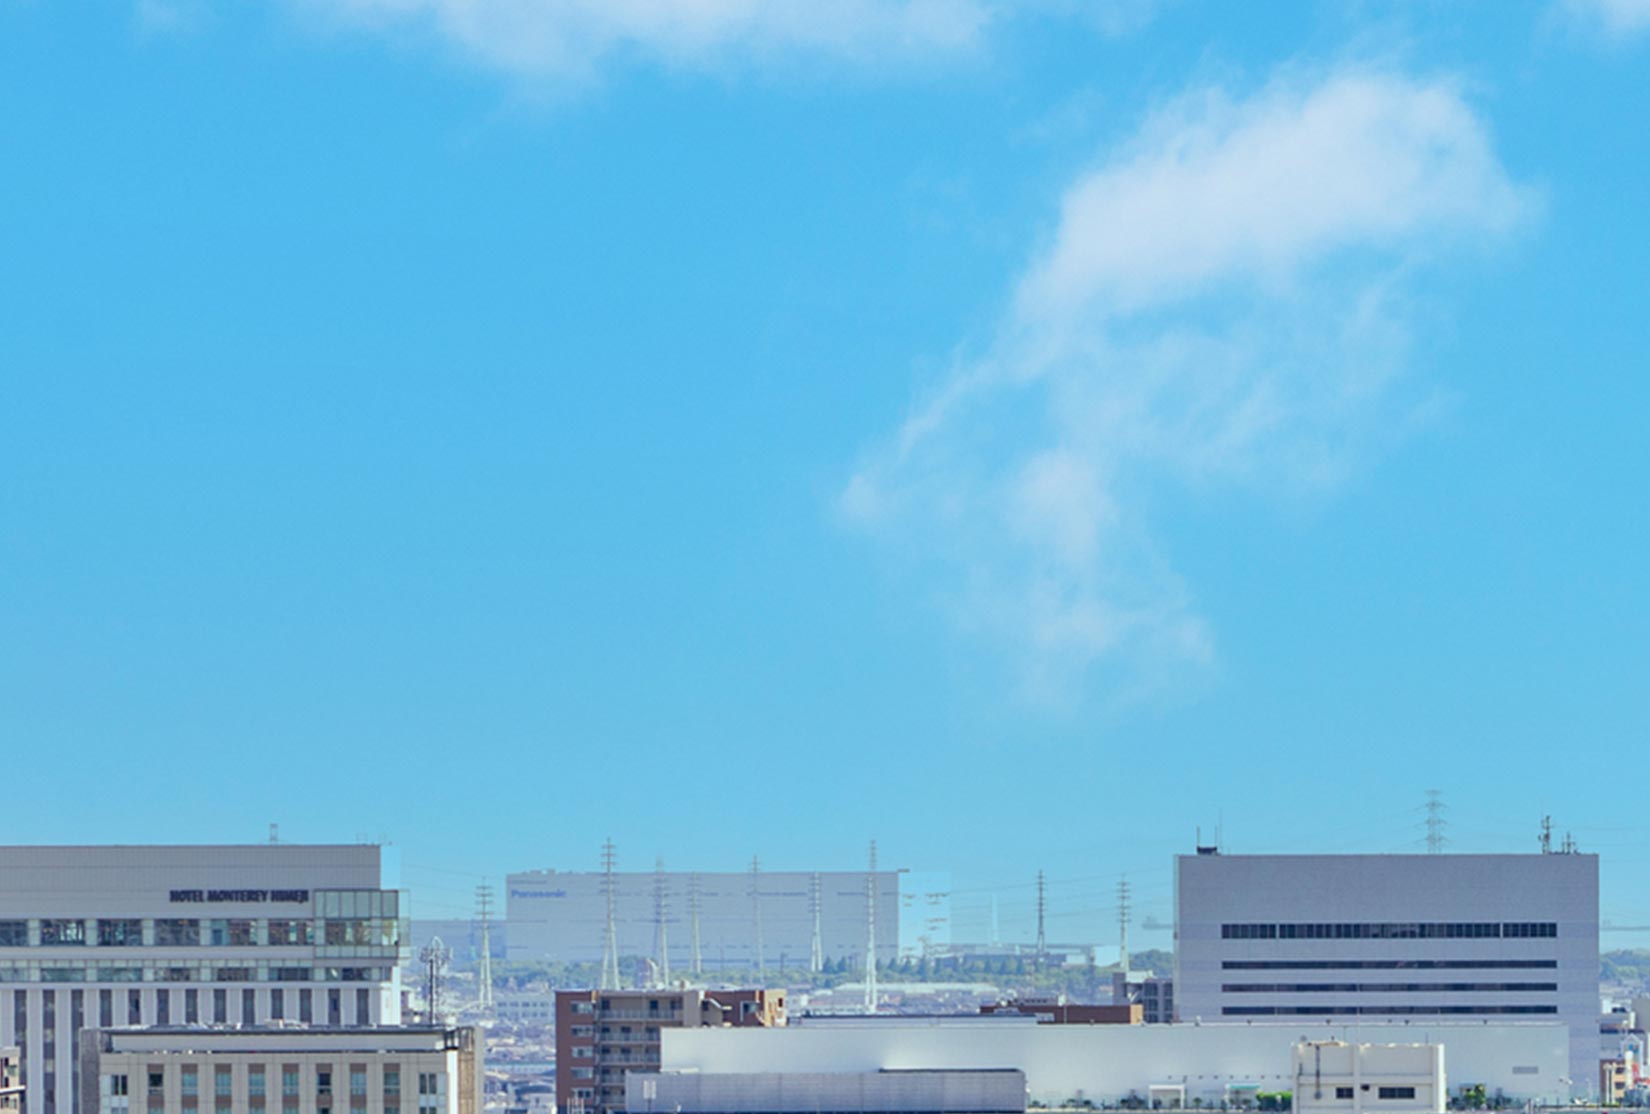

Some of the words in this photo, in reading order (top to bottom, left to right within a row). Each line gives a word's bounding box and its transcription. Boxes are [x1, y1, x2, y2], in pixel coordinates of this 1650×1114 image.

[169, 889, 204, 902] HOTEL
[207, 889, 268, 902] MONTEREY
[270, 889, 309, 904] HIMEJI
